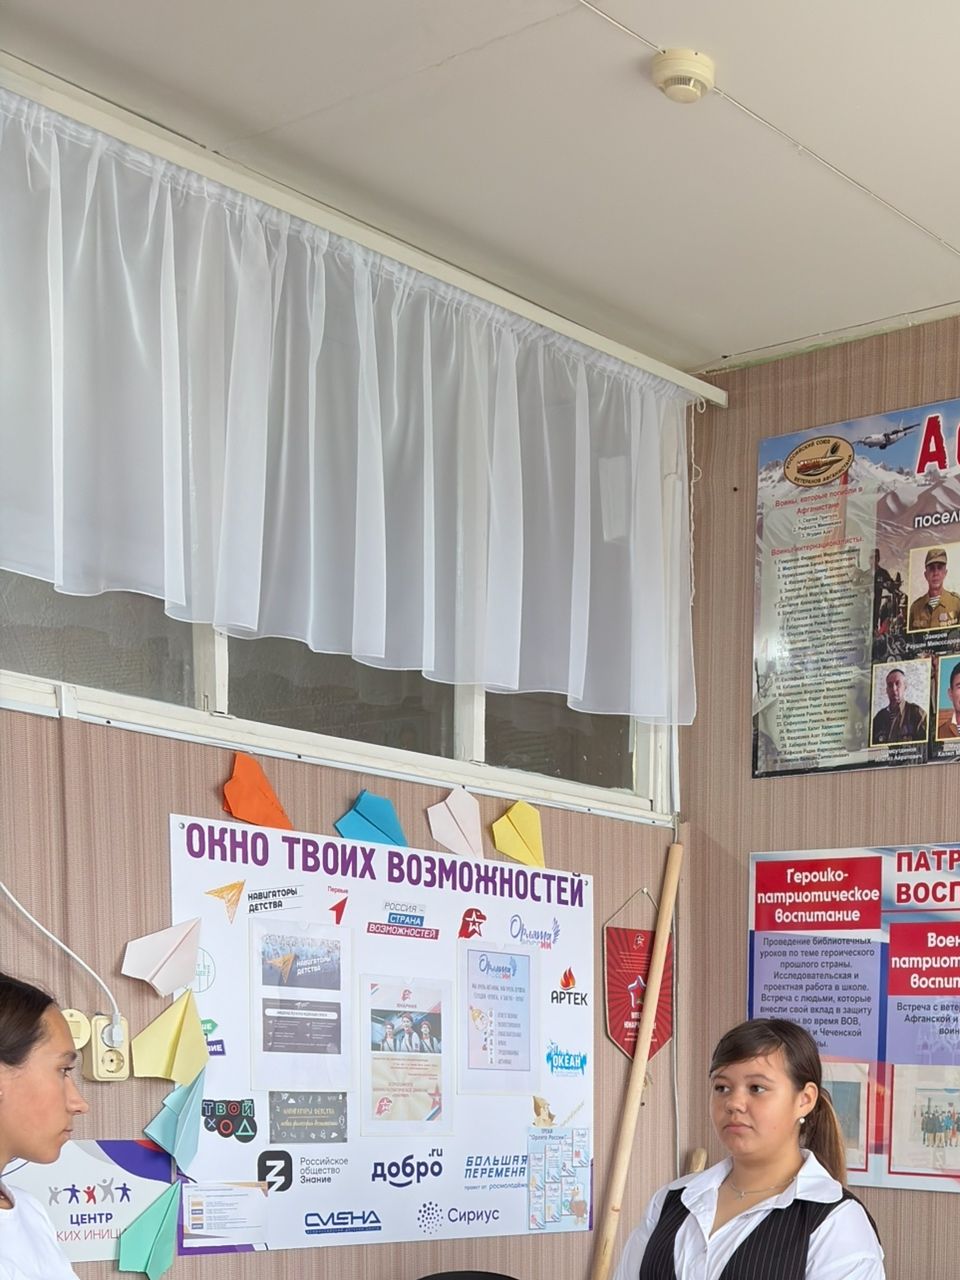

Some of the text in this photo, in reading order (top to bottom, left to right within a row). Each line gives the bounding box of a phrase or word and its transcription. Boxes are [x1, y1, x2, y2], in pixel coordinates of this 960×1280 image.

[186, 822, 584, 908] ОКНО ТВОИХ ВОЗМОЖНОСТЕЙ
[786, 868, 849, 884] Героико-
[248, 888, 298, 902] НАВИГАТОРЫ
[757, 886, 880, 906] патриотическое
[248, 901, 283, 913] ДЕТСТВА
[384, 902, 417, 912] РОССИЯ
[390, 914, 422, 925] СТРАНА
[775, 908, 860, 924] воспитание
[369, 924, 436, 938] ВОЗМОЖНОСТЕЙ
[764, 937, 871, 947] Проведение библиотечных
[760, 951, 786, 959] уроков
[821, 949, 874, 958] героического
[780, 961, 852, 969] прошлого страны.
[774, 972, 851, 980] Исследовательская
[764, 984, 803, 992] проектная
[806, 983, 832, 992] работа
[551, 990, 588, 1006] АРТЕК
[761, 994, 792, 1003] Встреча
[801, 995, 835, 1003] людьми,
[837, 995, 871, 1004] которые
[790, 1005, 808, 1013] свой
[811, 1007, 833, 1015] вклад
[843, 1007, 872, 1015] защиту
[897, 1003, 931, 1013] Встреча
[904, 1014, 950, 1025] Афганской
[552, 1055, 581, 1067] ОКЕАН
[203, 1099, 254, 1117] ТВОЙ
[300, 1156, 348, 1167] Российское
[466, 1155, 528, 1166] БОЛЬШАЯ
[300, 1166, 340, 1177] общество
[464, 1167, 526, 1178] ПЕРЕМЕНА
[300, 1175, 332, 1184] Знание
[70, 1212, 113, 1225] ЦЕНТР
[304, 1210, 381, 1227] СМЕНА
[448, 1206, 500, 1224] Сириус
